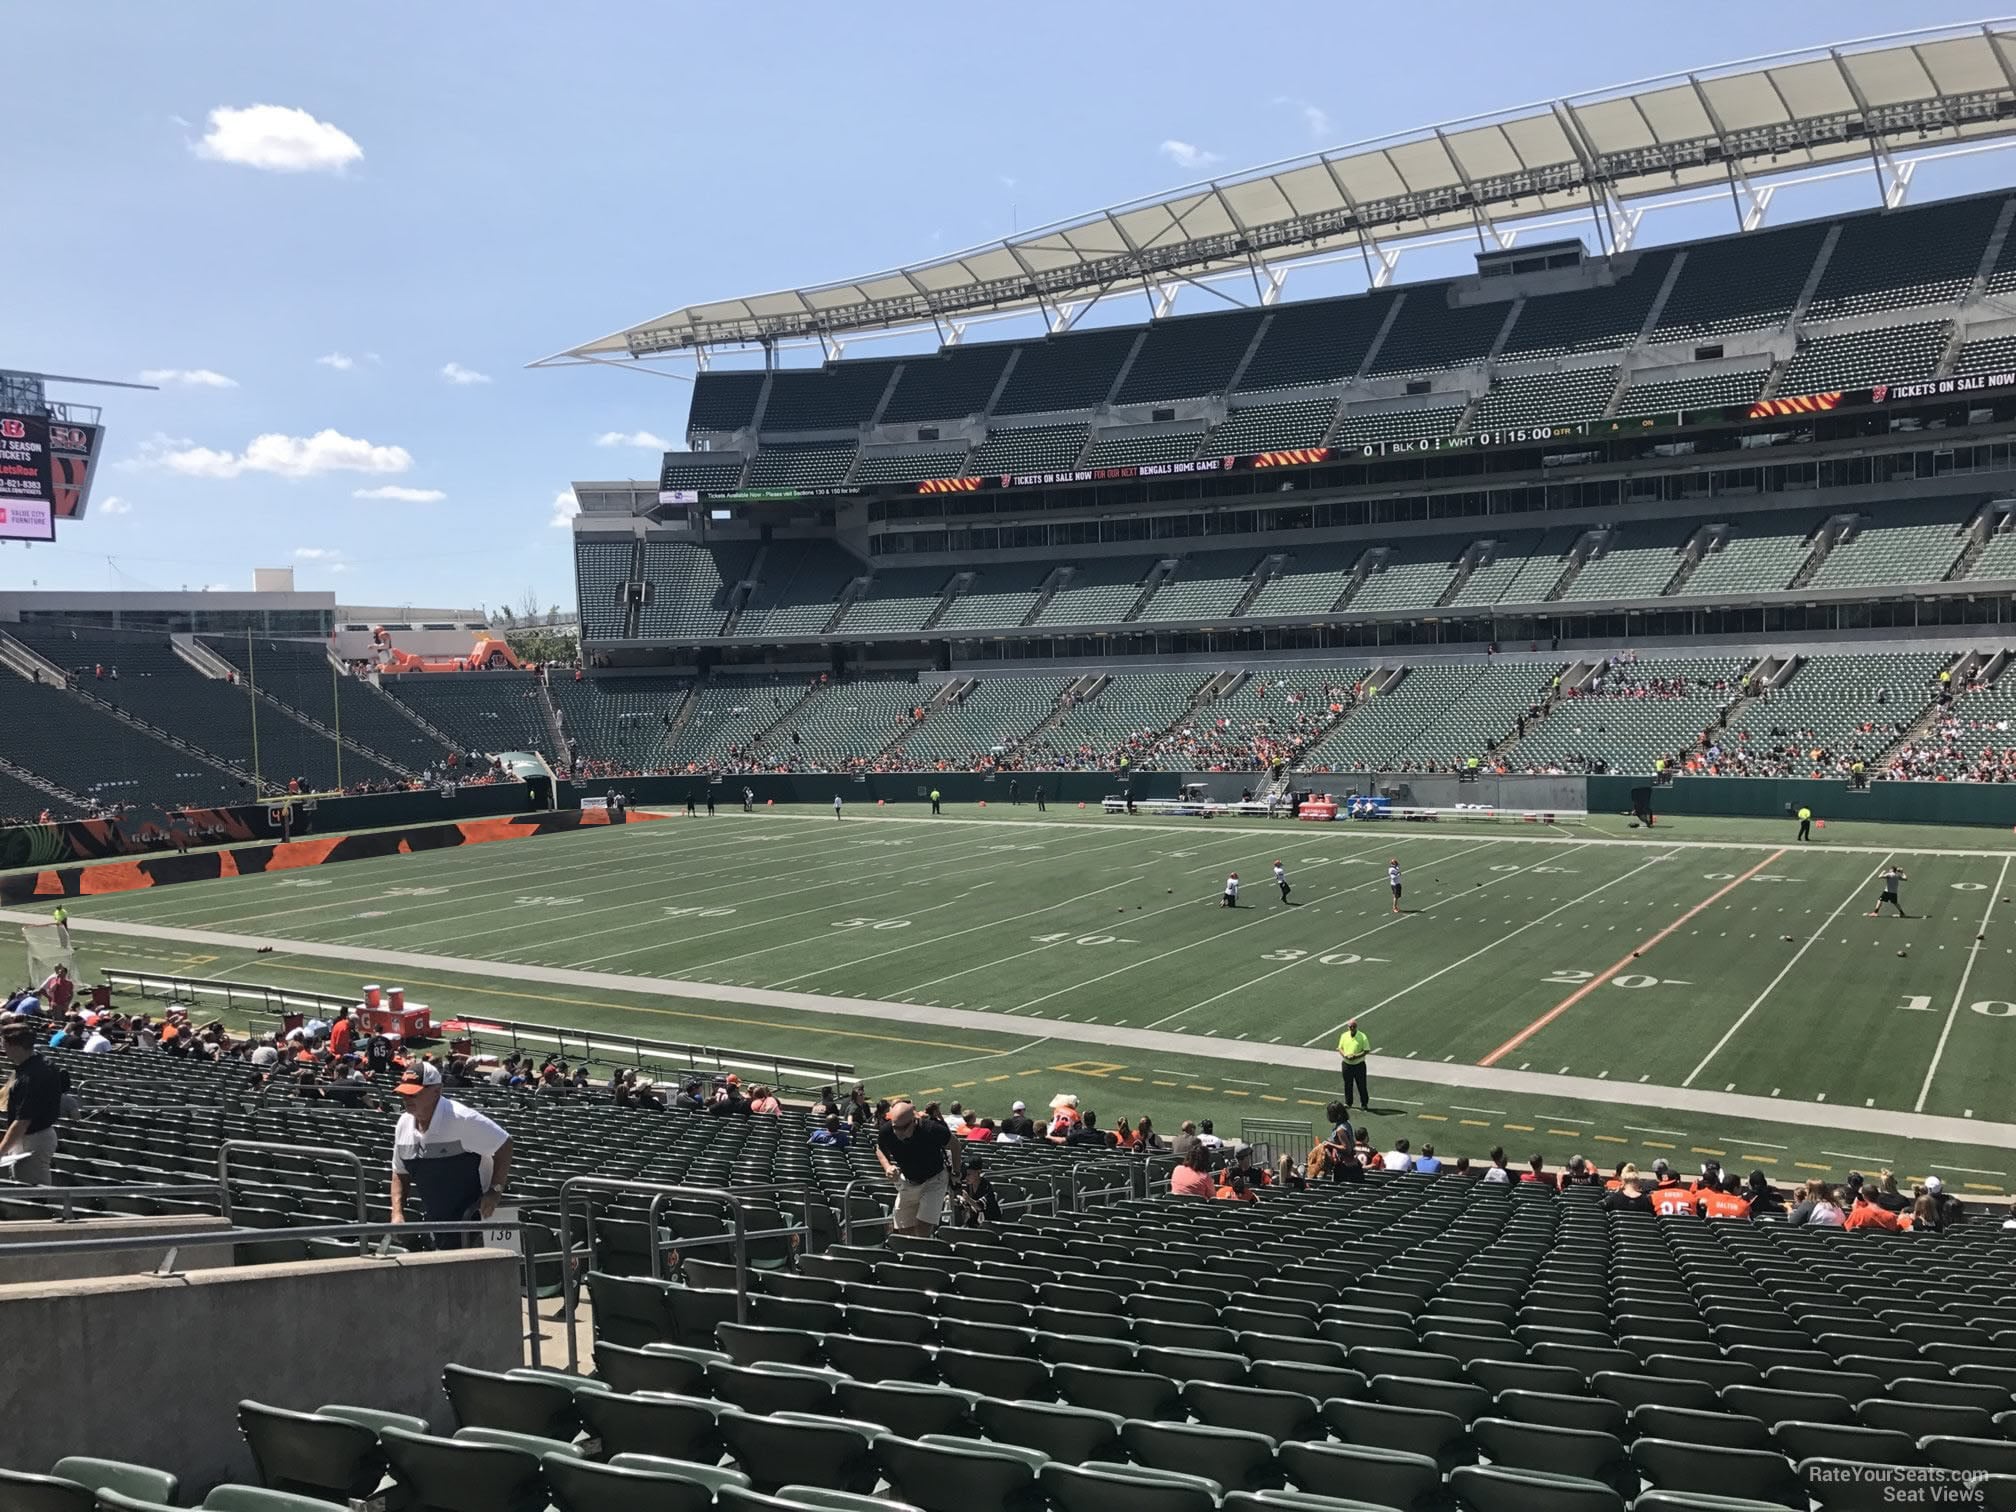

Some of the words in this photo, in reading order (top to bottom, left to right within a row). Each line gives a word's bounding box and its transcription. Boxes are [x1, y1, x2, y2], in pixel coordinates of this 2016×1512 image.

[1892, 383, 1935, 398] TICKETS
[1939, 380, 1954, 392] ON
[1957, 377, 1985, 390] SALE
[1988, 372, 2016, 386] NOW
[9, 440, 42, 453] SEASON
[1363, 445, 1373, 456] 0
[1392, 442, 1414, 452] BLK
[1420, 439, 1429, 450] 0
[1448, 436, 1475, 447] WHT
[1480, 433, 1489, 444] 0
[1508, 427, 1551, 442] 15:00
[1553, 427, 1571, 436] QTR
[0, 450, 31, 461] TICKETS
[1014, 475, 1042, 485] TICKETS
[1043, 474, 1053, 483] ON
[1055, 472, 1073, 482] SALE
[1075, 471, 1092, 481] NOW
[1094, 470, 1105, 479] FOR
[1107, 469, 1119, 478] OUR
[1121, 467, 1137, 477] NEXT
[1139, 464, 1171, 476] BENGALS
[1173, 462, 1194, 473] HOME
[1196, 460, 1220, 471] GAME!
[830, 917, 912, 930] 50
[1260, 948, 1362, 966] 30
[1540, 969, 1659, 989] 20
